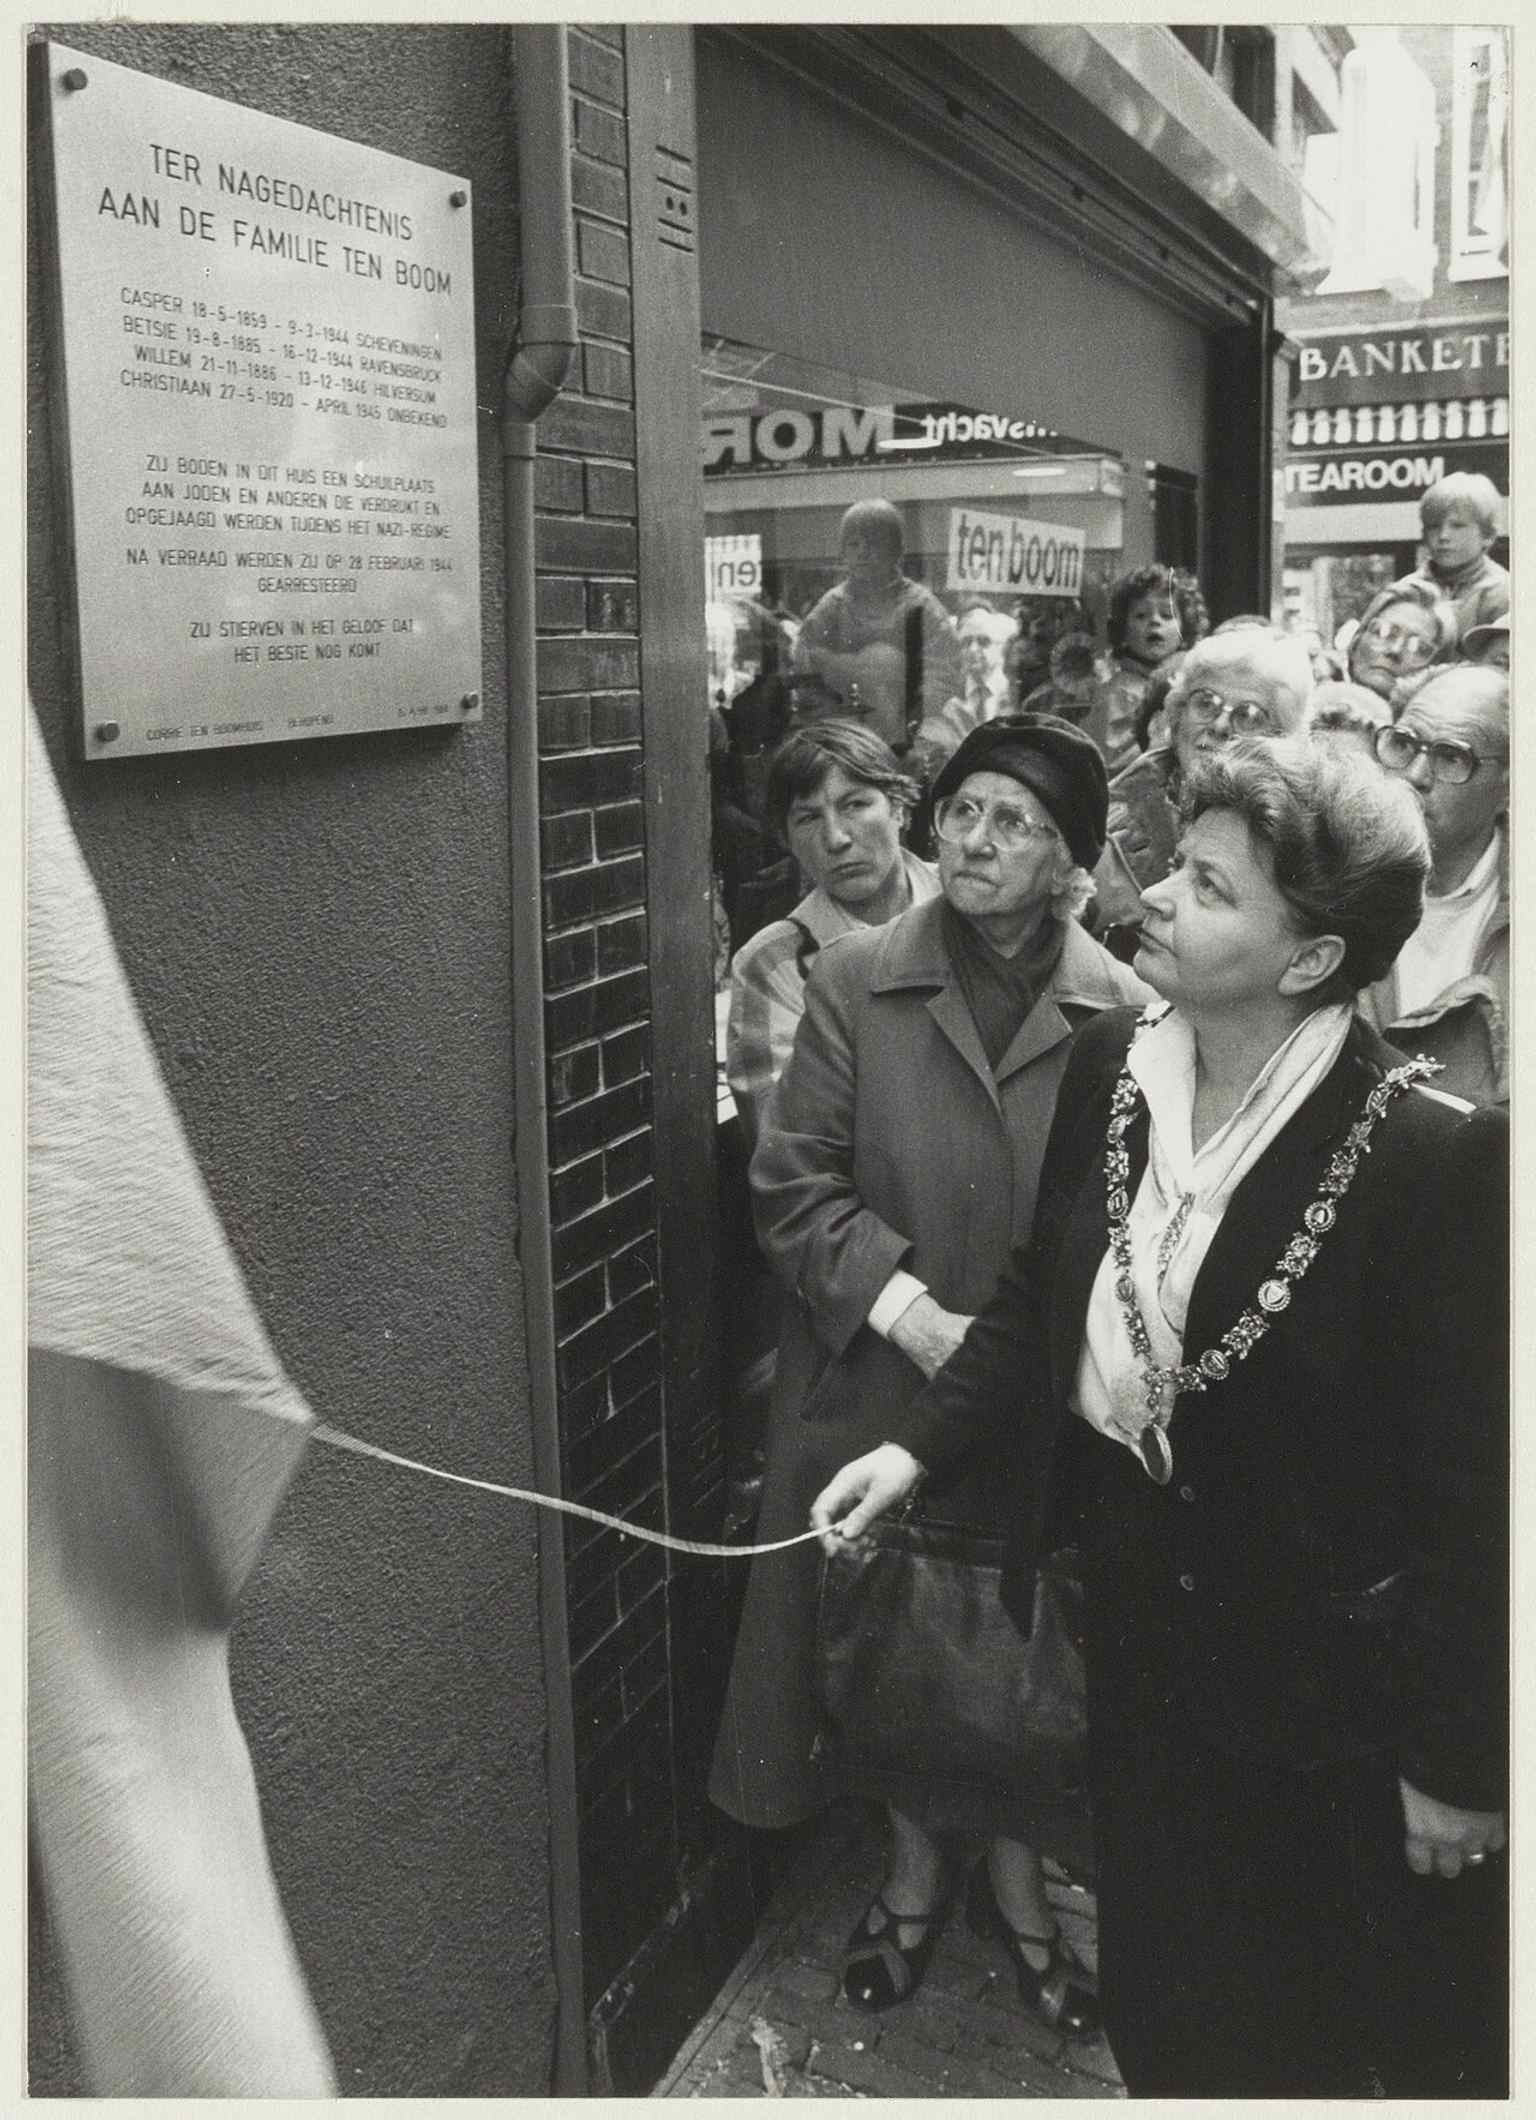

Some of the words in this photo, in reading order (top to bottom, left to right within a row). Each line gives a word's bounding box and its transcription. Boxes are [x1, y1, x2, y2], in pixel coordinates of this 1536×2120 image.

[150, 143, 202, 185] TER
[218, 163, 413, 241] NAGEDACHTENIS
[98, 186, 160, 229] AAN
[180, 206, 216, 242] DE
[233, 219, 329, 268] FAMILIE
[342, 246, 382, 281] TEN
[395, 259, 452, 296] BOOM
[120, 286, 184, 313] CASPER
[123, 315, 177, 340] BETSIE
[134, 343, 192, 369] WILLEM
[120, 368, 212, 397] CHRISTIAAN
[315, 397, 352, 416] APRIL
[386, 406, 449, 429] ONBEKEND
[146, 454, 168, 472] ZIJ
[177, 457, 228, 477] BODEN
[236, 463, 250, 479] IN
[258, 464, 278, 482] DIT
[286, 467, 316, 485] HUIS
[322, 470, 348, 487] EEN
[1283, 456, 1445, 493] TEAROOM
[142, 481, 175, 499] AAN
[183, 484, 231, 503] JODEN
[239, 487, 258, 504] EN
[266, 490, 328, 510] ANDEREN
[334, 494, 354, 511] DIE
[424, 501, 441, 516] EN
[125, 506, 217, 528] OPGEJAAGD
[223, 513, 283, 531] WERDEN
[290, 515, 342, 534] TIJDENS
[347, 519, 371, 536] HET
[126, 548, 150, 565] NA
[158, 549, 228, 567] VERRAAD
[236, 552, 293, 568] WERDEN
[300, 553, 319, 569] ZIJ
[325, 553, 343, 570] OP
[367, 555, 425, 571] FEBRUARI
[257, 576, 358, 593] GEARRESTEERD
[189, 621, 211, 639] ZIJ
[219, 619, 284, 638] STIERVEN
[291, 619, 305, 636] IN
[312, 618, 336, 635] HET
[342, 617, 387, 635] GELOOF
[392, 617, 415, 633] DAT
[233, 645, 261, 664] HET
[267, 643, 310, 662] BESTE
[315, 643, 342, 660] NOG
[348, 641, 382, 659] KOMT
